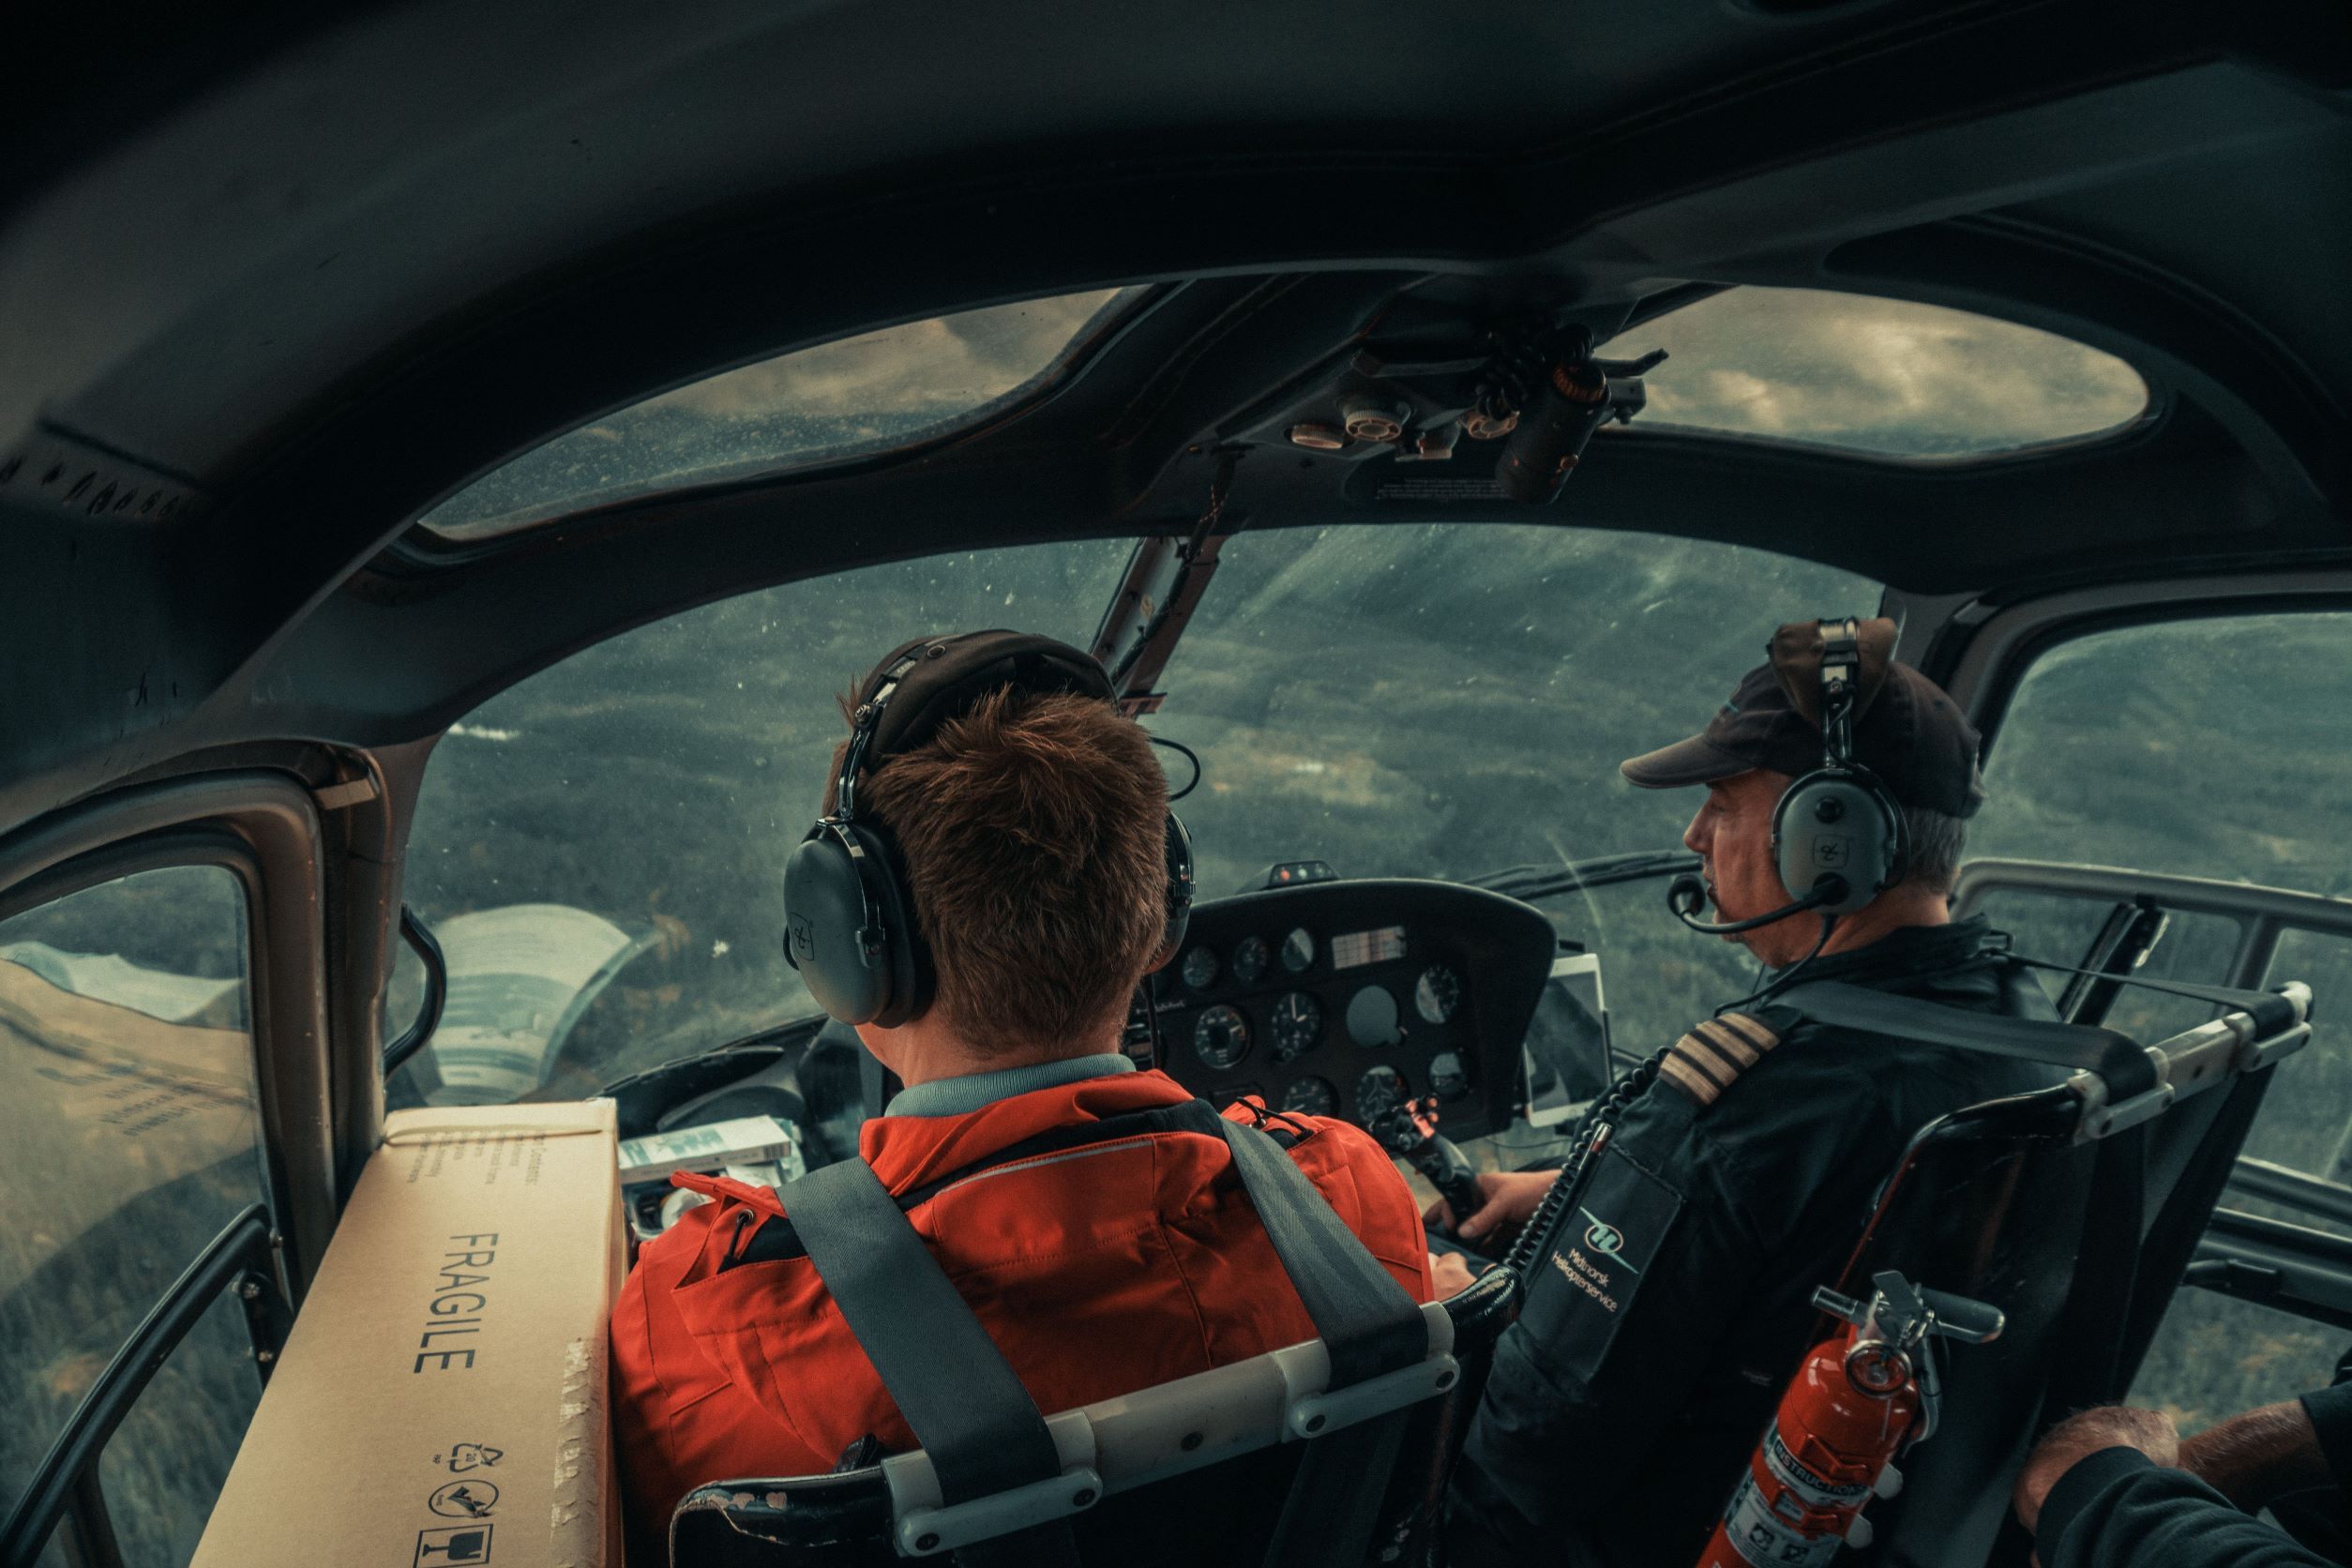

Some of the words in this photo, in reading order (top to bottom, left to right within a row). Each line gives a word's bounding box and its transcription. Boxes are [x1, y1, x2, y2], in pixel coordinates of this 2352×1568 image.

[1552, 1251, 1618, 1312] Helikopterservice
[1569, 1247, 1609, 1288] Midtnorsk
[414, 1233, 499, 1374] FRAGILE
